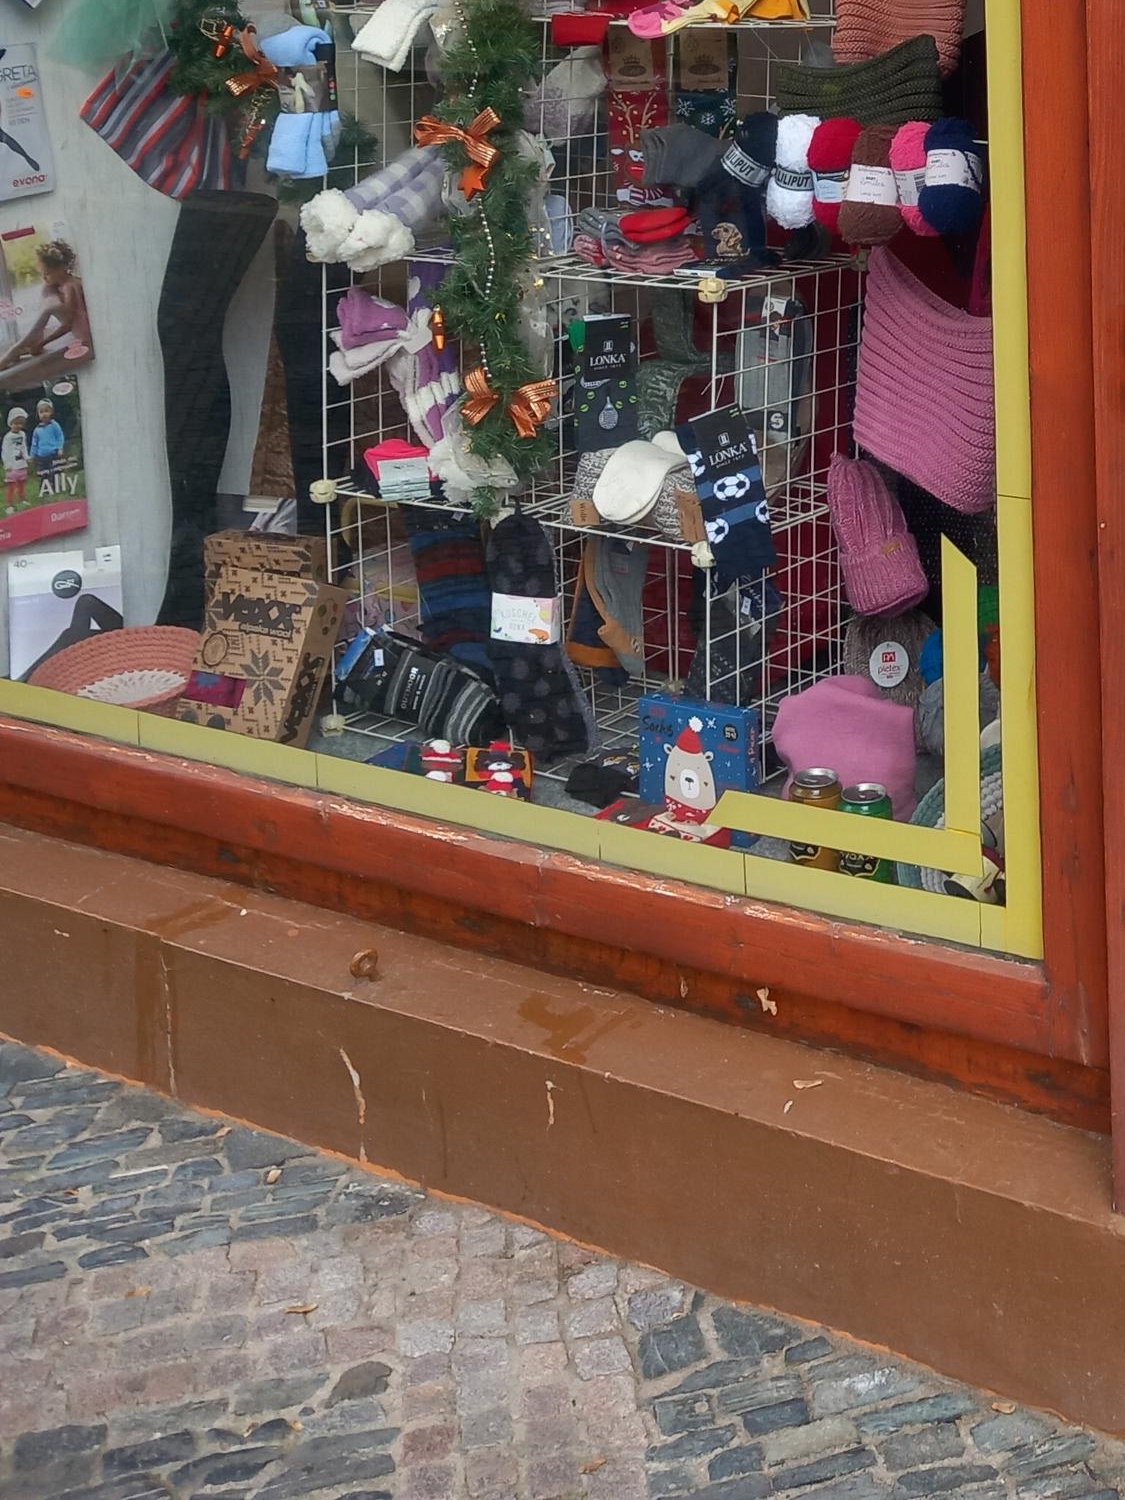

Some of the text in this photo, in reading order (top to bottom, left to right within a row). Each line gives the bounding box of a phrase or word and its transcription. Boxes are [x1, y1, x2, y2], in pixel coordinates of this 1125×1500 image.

[777, 171, 811, 187] LILIPUT
[589, 353, 625, 367] LONKA
[708, 441, 747, 466] LONKA
[39, 472, 79, 498] Ally
[13, 559, 28, 569] 40
